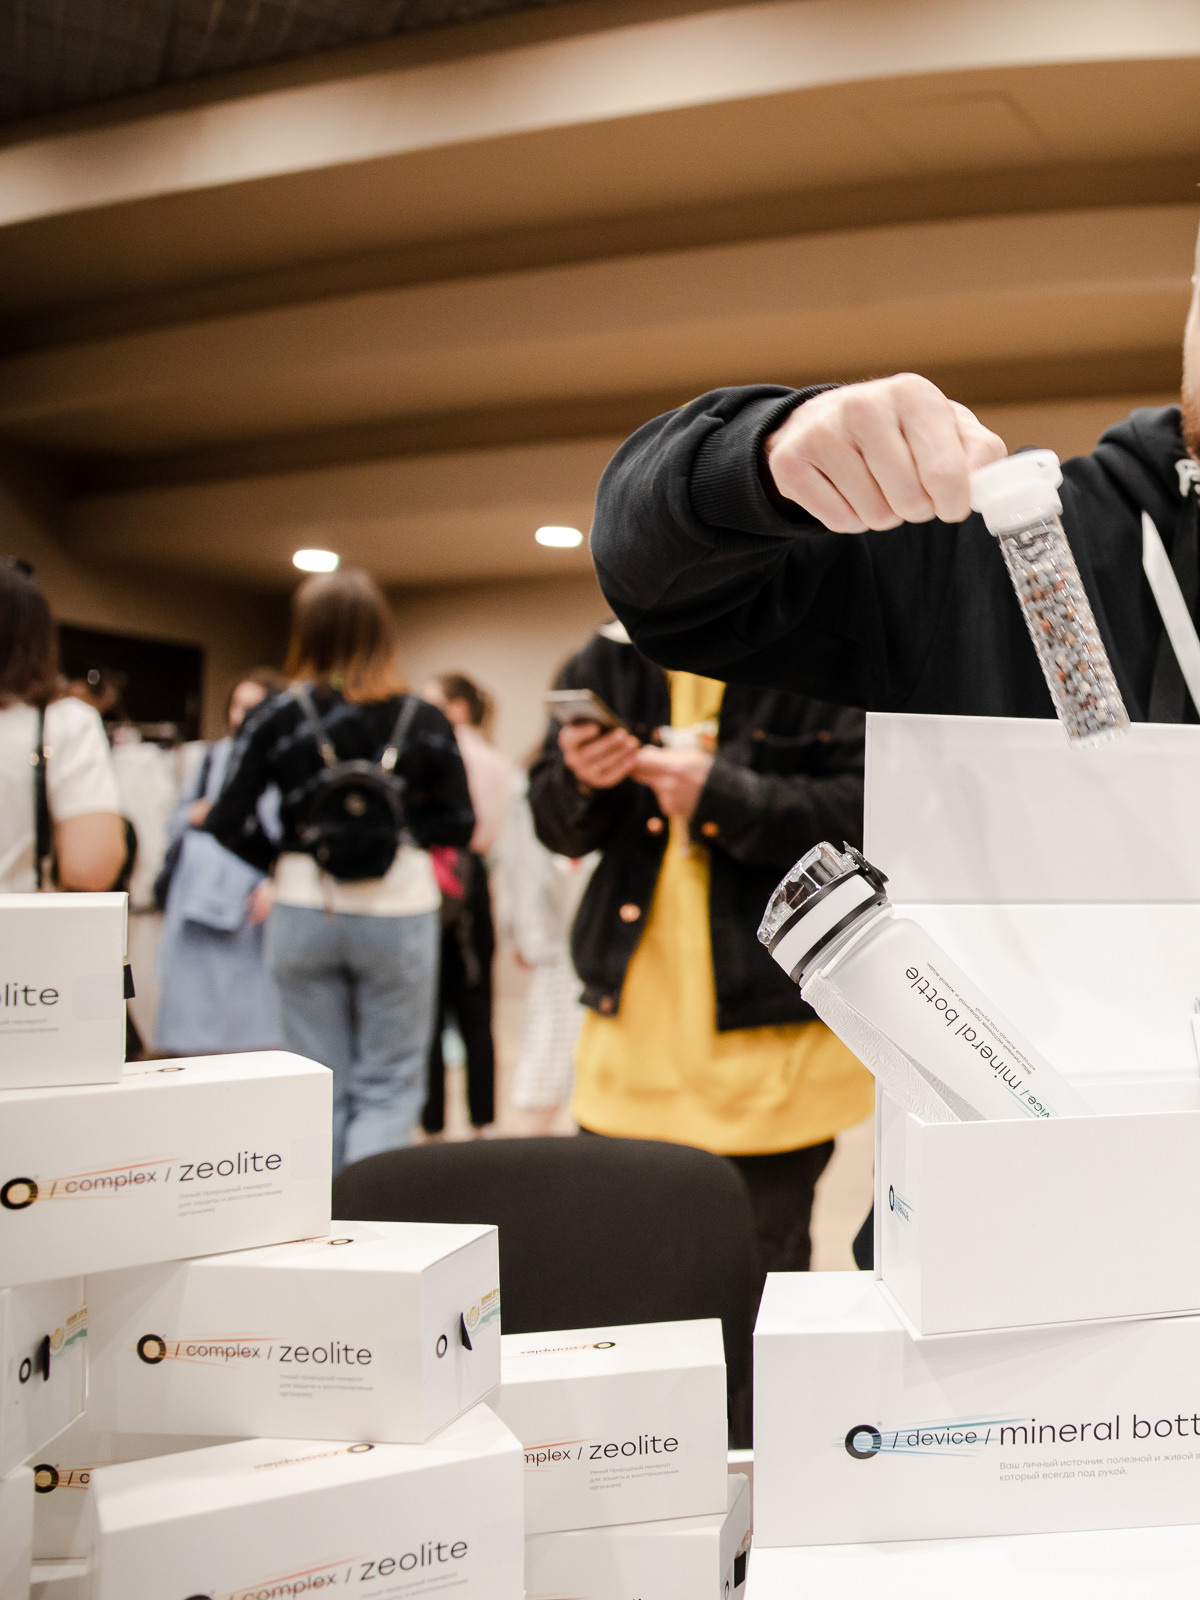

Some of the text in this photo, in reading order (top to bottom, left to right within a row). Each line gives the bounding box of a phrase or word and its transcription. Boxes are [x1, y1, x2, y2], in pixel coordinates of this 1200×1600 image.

[0, 982, 59, 1007] lite
[905, 966, 960, 1027] bottle
[954, 1023, 1022, 1090] mineral
[1027, 1096, 1051, 1118] vice
[64, 1170, 157, 1193] complex
[179, 1151, 282, 1182] zeolite
[186, 1343, 260, 1362] complex
[279, 1341, 372, 1365] zeolite
[907, 1428, 977, 1446] device
[1001, 1415, 1119, 1446] mineral
[524, 1449, 571, 1466] mplex
[589, 1434, 679, 1460] zeolite
[1000, 1462, 1020, 1470] Ваш
[1022, 1459, 1058, 1469] личный
[1060, 1458, 1103, 1467] источник
[1106, 1453, 1152, 1464] полезной
[1163, 1451, 1193, 1461] живой
[999, 1472, 1040, 1482] который
[1042, 1471, 1075, 1479] всегда
[360, 1541, 468, 1581] zeolite
